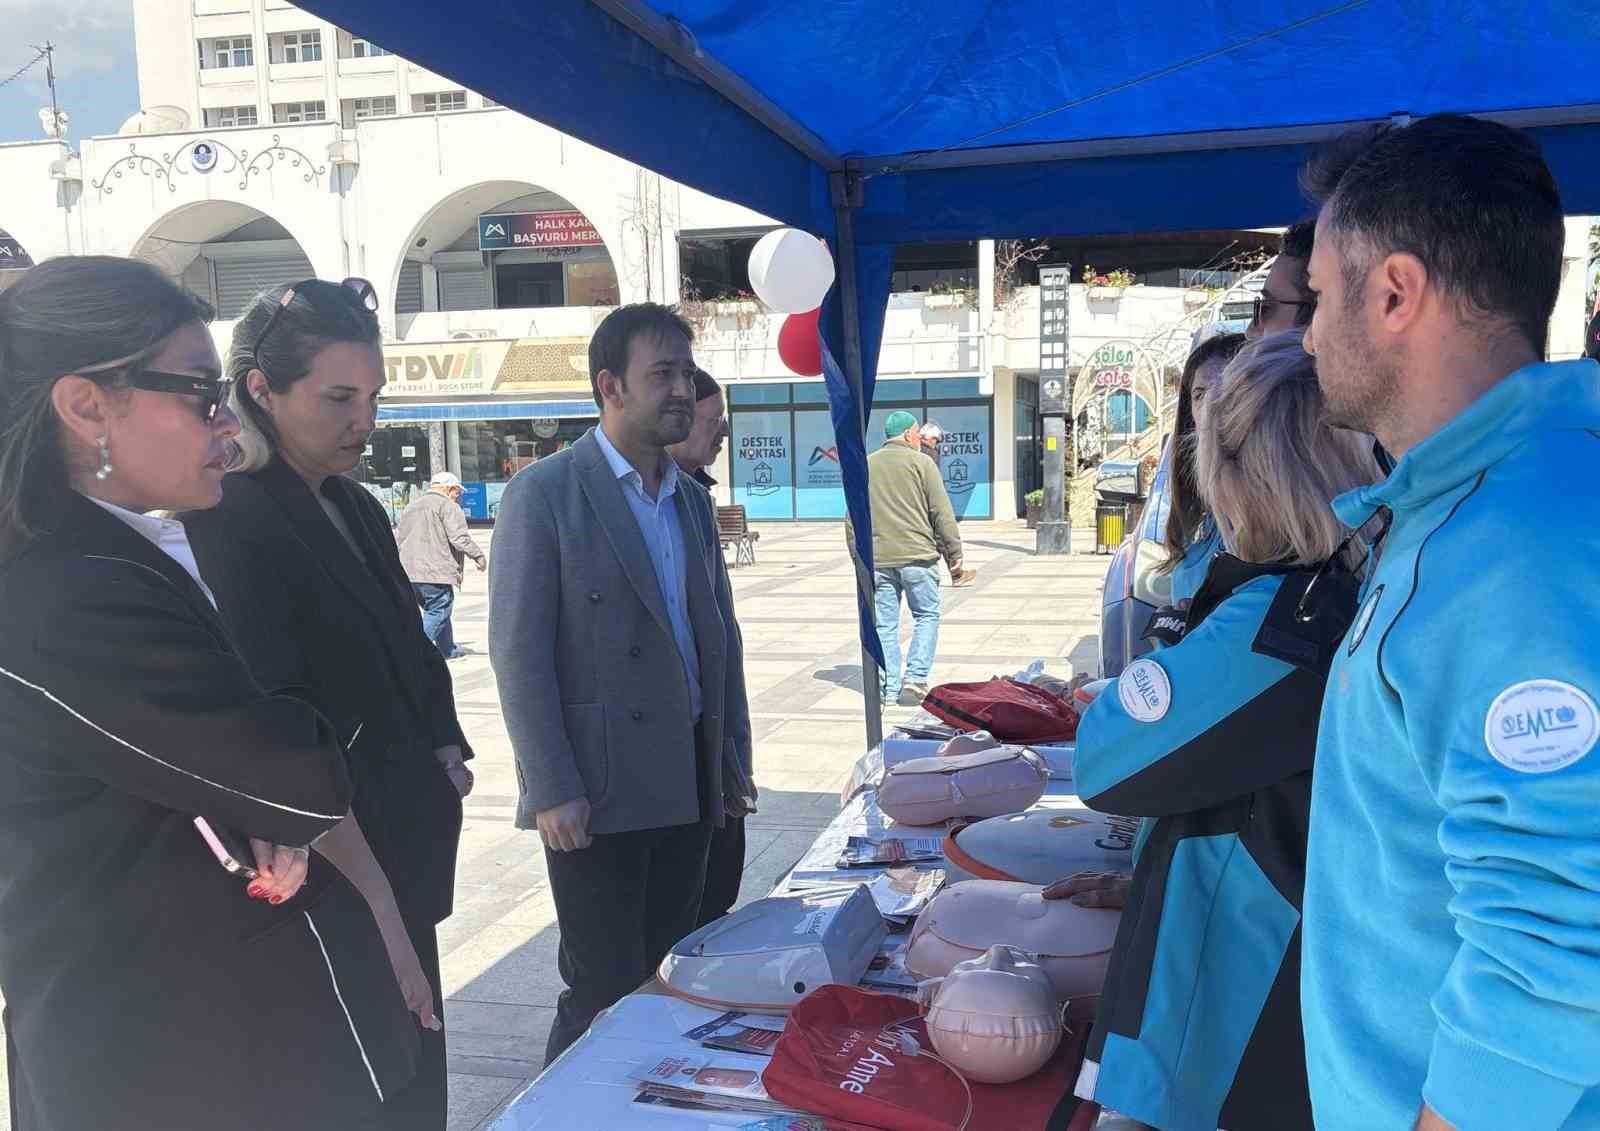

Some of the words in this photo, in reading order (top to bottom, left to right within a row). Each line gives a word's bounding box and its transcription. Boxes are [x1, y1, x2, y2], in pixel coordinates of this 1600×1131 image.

[535, 218, 566, 230] HALK
[568, 217, 593, 229] KAR
[513, 231, 569, 245] BAŞVURU
[741, 436, 783, 447] DESTEK
[739, 447, 786, 460] NOKTASI
[839, 1048, 896, 1094] Anne
